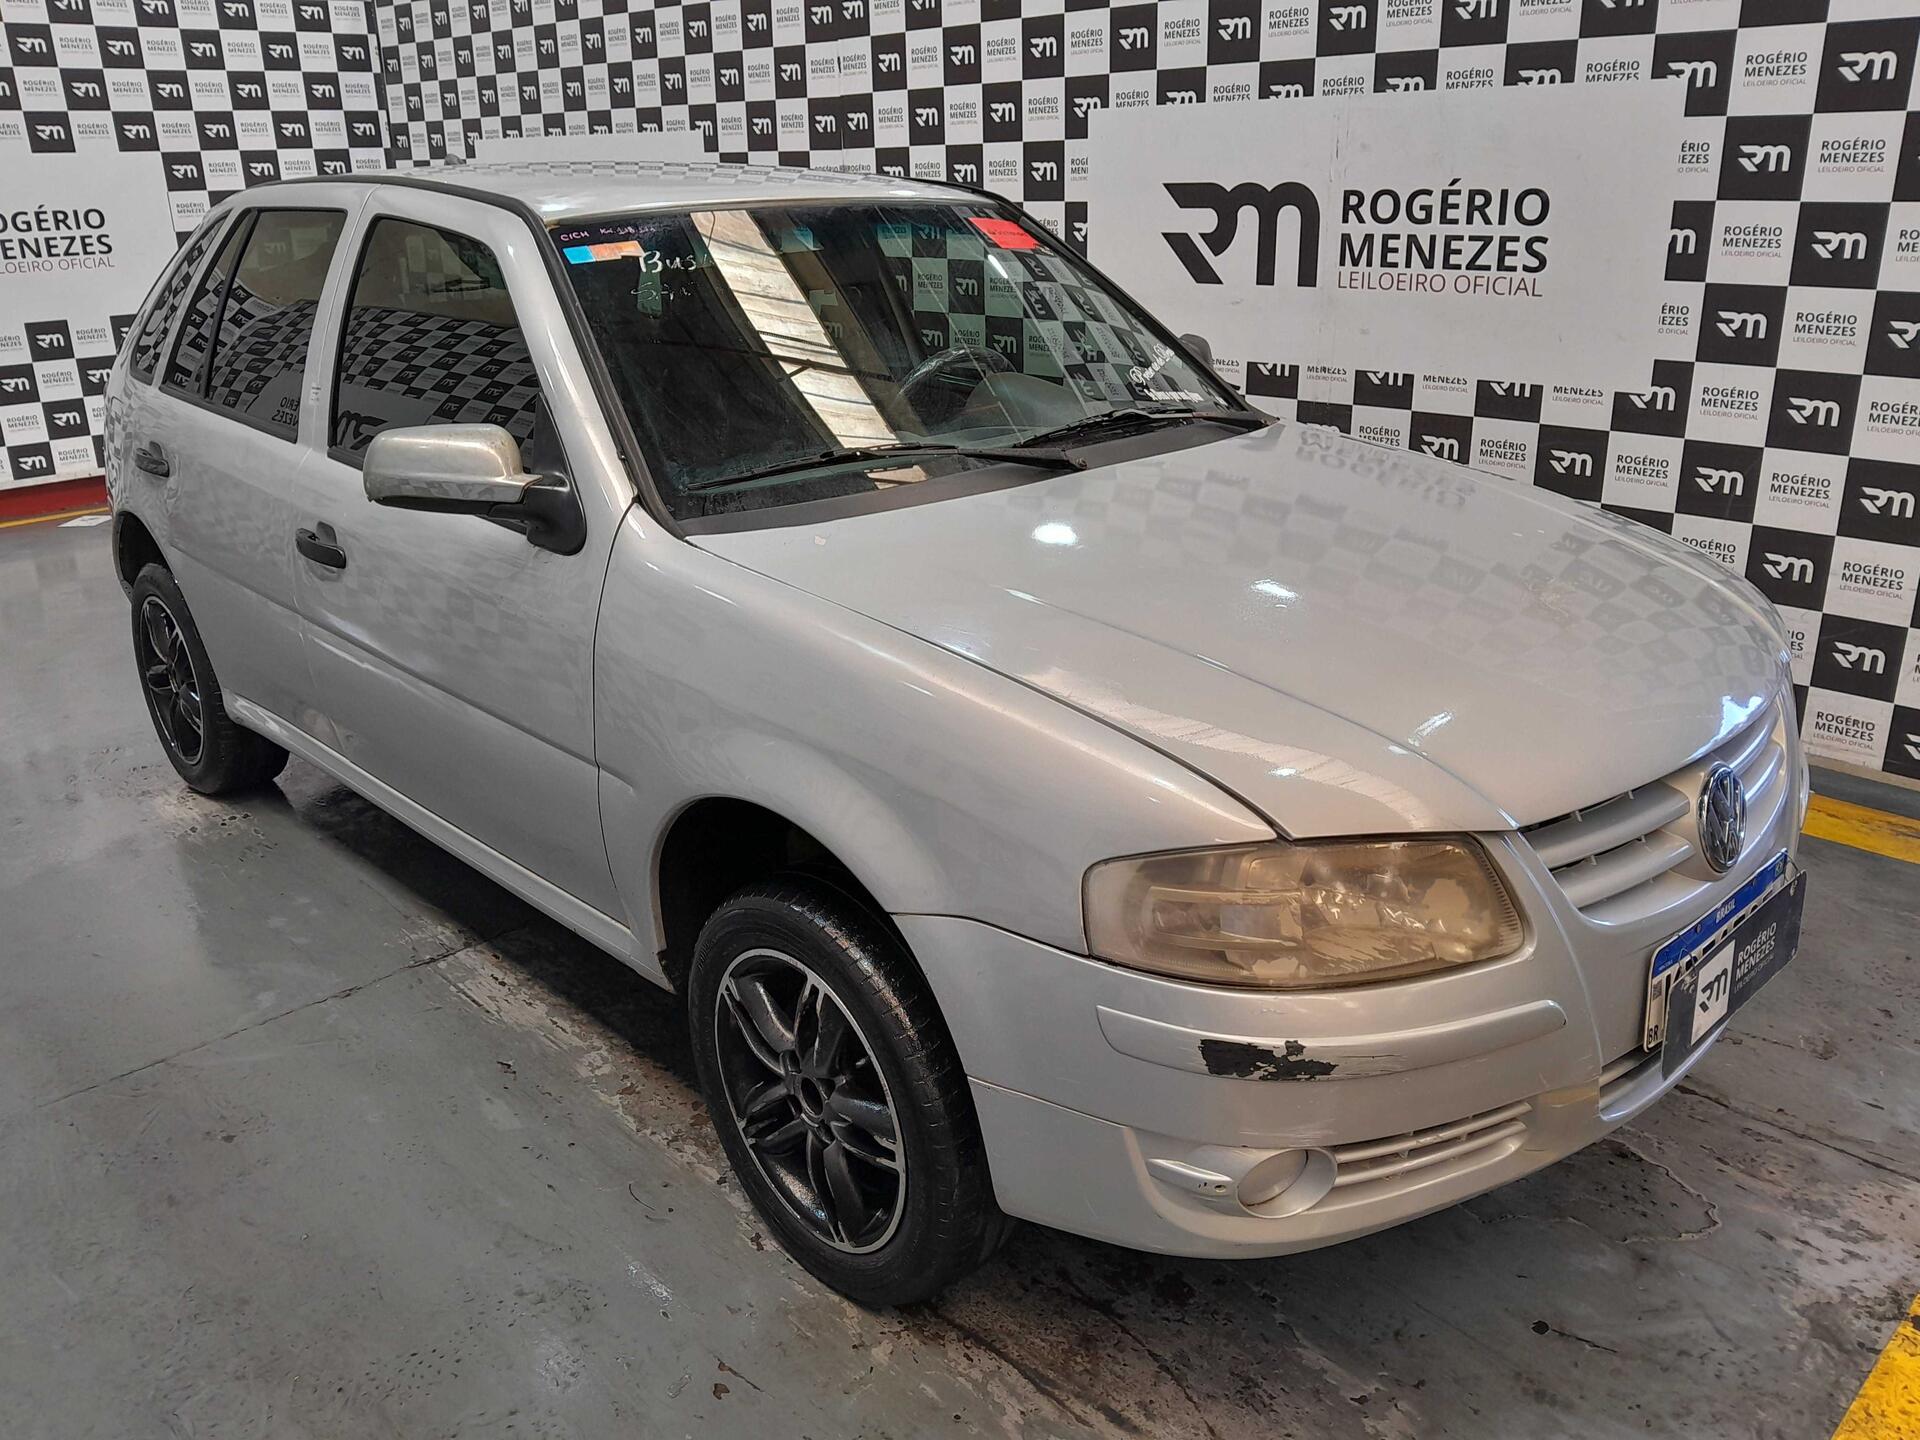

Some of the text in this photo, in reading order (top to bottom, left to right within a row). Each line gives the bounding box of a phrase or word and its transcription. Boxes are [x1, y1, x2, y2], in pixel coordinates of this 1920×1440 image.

[776, 7, 799, 16] ROGÉRIO
[1269, 6, 1309, 20] ROGÉRIO
[1386, 5, 1432, 18] MENEZES
[776, 14, 800, 24] MENEZES
[1164, 17, 1200, 30] ROGÉRIO
[1268, 17, 1309, 30] MENEZES
[1071, 29, 1102, 40] ROGÉRIO
[1164, 28, 1200, 39] MENEZES
[987, 38, 1016, 48] ROGÉRIO
[1071, 37, 1103, 49] MENEZES
[912, 46, 937, 56] ROGÉRIO
[987, 46, 1016, 56] MENEZES
[843, 54, 866, 64] ROGÉRIO
[912, 54, 938, 64] MENEZES
[1745, 51, 1807, 66] ROGÉRIO
[748, 63, 770, 72] ROGÉRIO
[843, 61, 867, 70] MENEZES
[1586, 59, 1640, 73] ROGÉRIO
[1744, 64, 1807, 77] MENEZES
[748, 70, 770, 79] MENEZES
[1446, 68, 1493, 81] ROGÉRIO
[1323, 75, 1364, 89] ROGÉRIO
[1115, 89, 1149, 100] ROGÉRIO
[1213, 83, 1250, 95] ROGÉRIO
[950, 102, 976, 111] ROGÉRIO
[1028, 96, 1058, 106] ROGÉRIO
[878, 107, 903, 116] ROGÉRIO
[950, 110, 977, 119] MENEZES
[1028, 105, 1059, 115] MENEZES
[781, 114, 803, 122] ROGÉRIO
[879, 114, 903, 124] MENEZES
[781, 121, 804, 129] MENEZES
[1681, 140, 1710, 152] ÉRIO
[1821, 138, 1886, 151] ROGÉRIO
[1819, 150, 1885, 163] MENEZES
[915, 161, 940, 170] ROGÉRIO
[989, 160, 1017, 168] ROGÉRIO
[915, 169, 941, 178] MENEZES
[989, 168, 1017, 176] MENEZES
[1341, 177, 1551, 226] ROGÉRIO
[0, 204, 105, 233] GÉRIO
[1724, 225, 1782, 237] ROGÉRIO
[0, 234, 112, 260] ENEZES
[1722, 236, 1781, 248] MENEZES
[1338, 232, 1548, 273] MENEZES
[0, 257, 115, 274] OEIRO OFICIAL
[1337, 271, 1543, 297] LEILOEIRO OFICIAL
[1661, 303, 1689, 315] ÉRIO
[1796, 312, 1857, 325] ROGÉRIO
[1794, 324, 1856, 336] MENEZES
[1702, 386, 1759, 400] ROGÉRIO
[1701, 398, 1758, 411] MENEZES
[1870, 401, 1920, 414] ROGÉR
[1359, 424, 1400, 438] ROGÉRIO
[1480, 438, 1527, 452] ROGÉRIO
[1479, 448, 1526, 462] MENEZES
[1616, 454, 1669, 468] ROGÉRIO
[1615, 466, 1668, 479] MENEZES
[1772, 472, 1831, 488] ROGÉRIO
[1770, 484, 1830, 499] MENEZES
[1682, 537, 1736, 553] ROGÉRIO
[1844, 562, 1904, 580] ROGÉRIO
[1841, 572, 1903, 590] MENEZES
[1816, 711, 1875, 731] ROGÉRIO
[1815, 722, 1874, 742] MENEZES
[1738, 922, 1776, 966] ROGÉRIO
[1736, 937, 1775, 981] MENEZES
